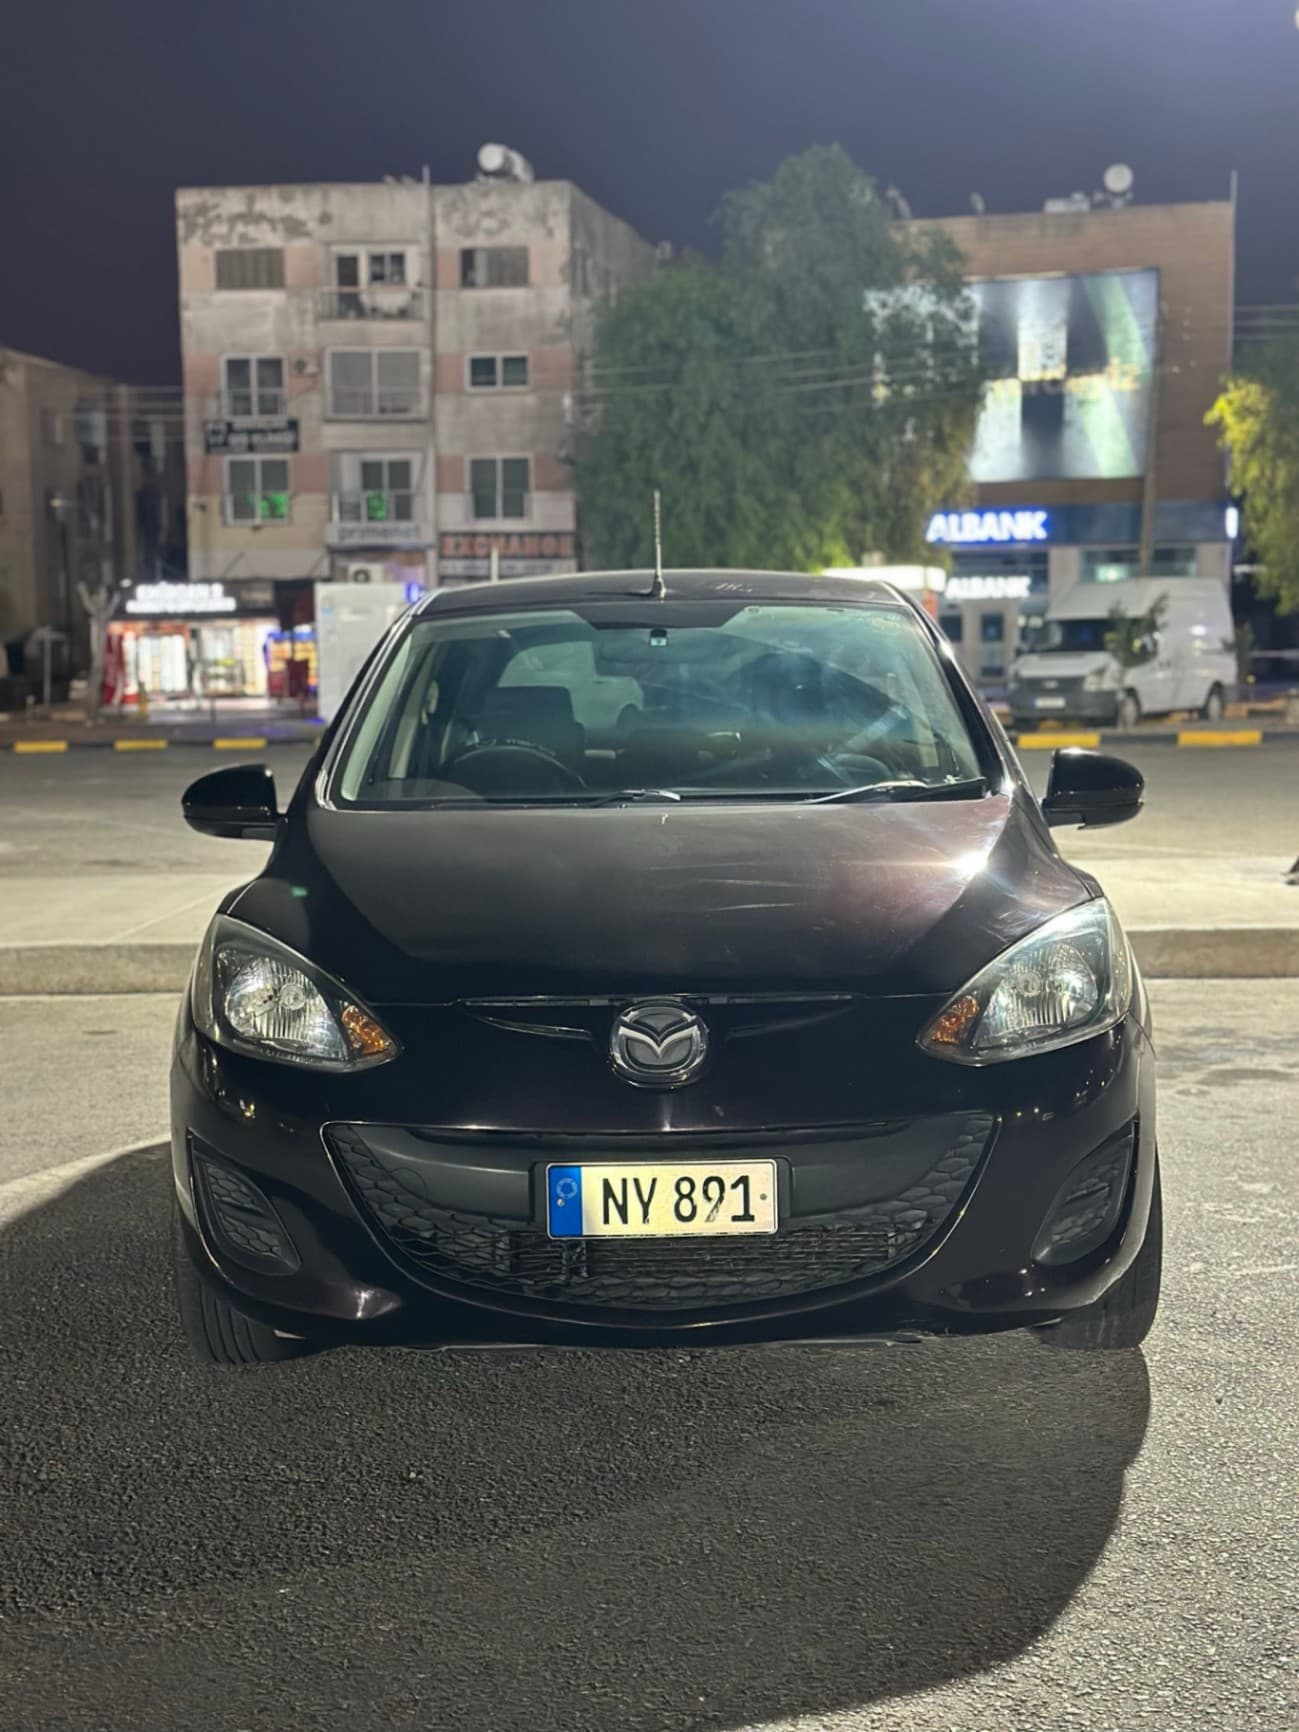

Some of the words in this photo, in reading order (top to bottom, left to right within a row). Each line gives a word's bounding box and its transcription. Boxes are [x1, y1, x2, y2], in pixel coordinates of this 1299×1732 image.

[926, 511, 1047, 542] ALBANK
[602, 1177, 657, 1224] NY
[673, 1175, 755, 1222] 891
